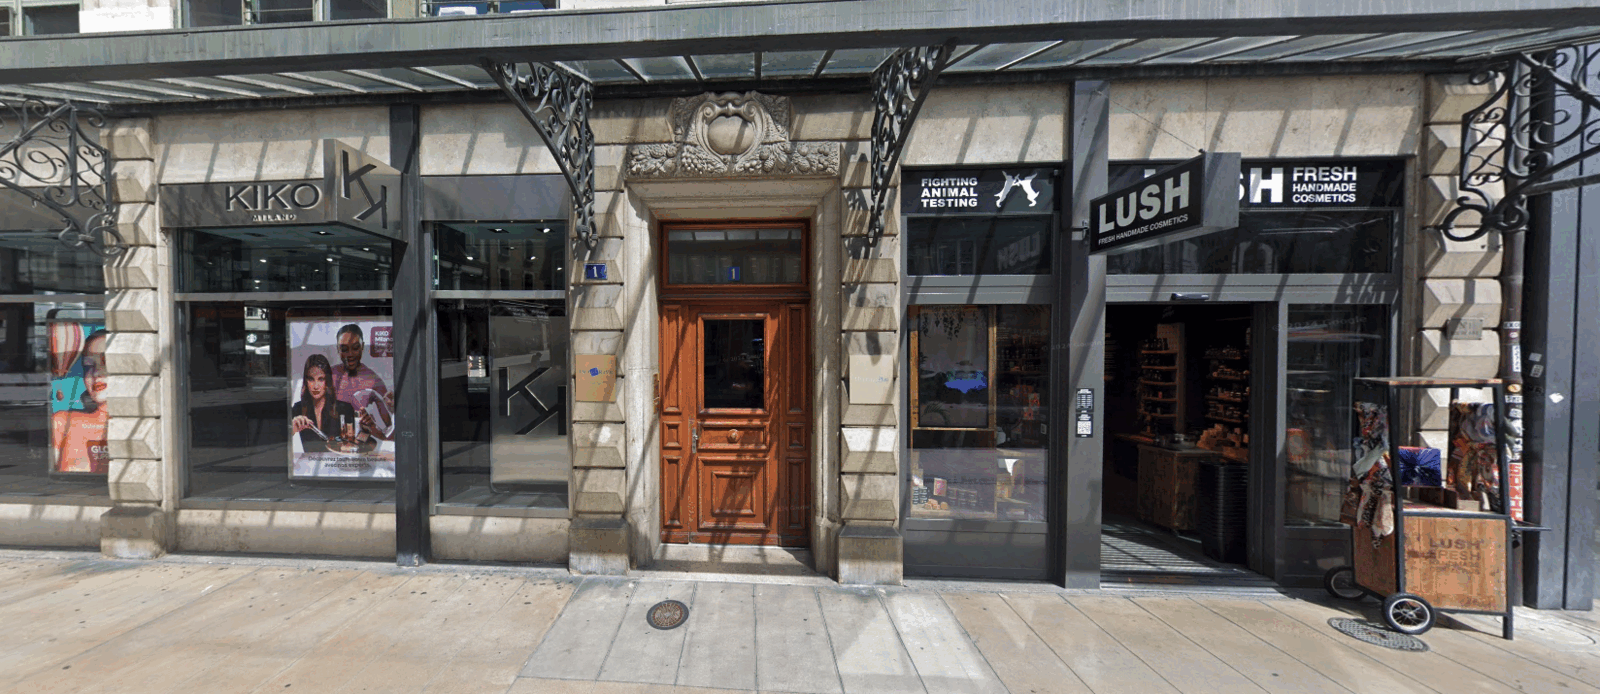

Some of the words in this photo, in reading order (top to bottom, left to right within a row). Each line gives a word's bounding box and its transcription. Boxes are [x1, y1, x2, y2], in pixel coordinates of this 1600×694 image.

[1292, 166, 1357, 181] FRESH
[921, 177, 978, 187] FIGHTING
[1292, 183, 1357, 192] HANDMADE
[225, 183, 323, 212] KIKO
[921, 187, 978, 198] ANIMAL
[1292, 193, 1357, 203] COSMETICS
[920, 198, 978, 208] TESTING
[1098, 170, 1190, 234] LUSH
[252, 214, 298, 222] MILANO
[1098, 234, 1116, 246] FRESH
[1116, 224, 1149, 241] HANDMADE
[1150, 213, 1189, 231] COSMETICS
[1429, 538, 1480, 550] LUSH
